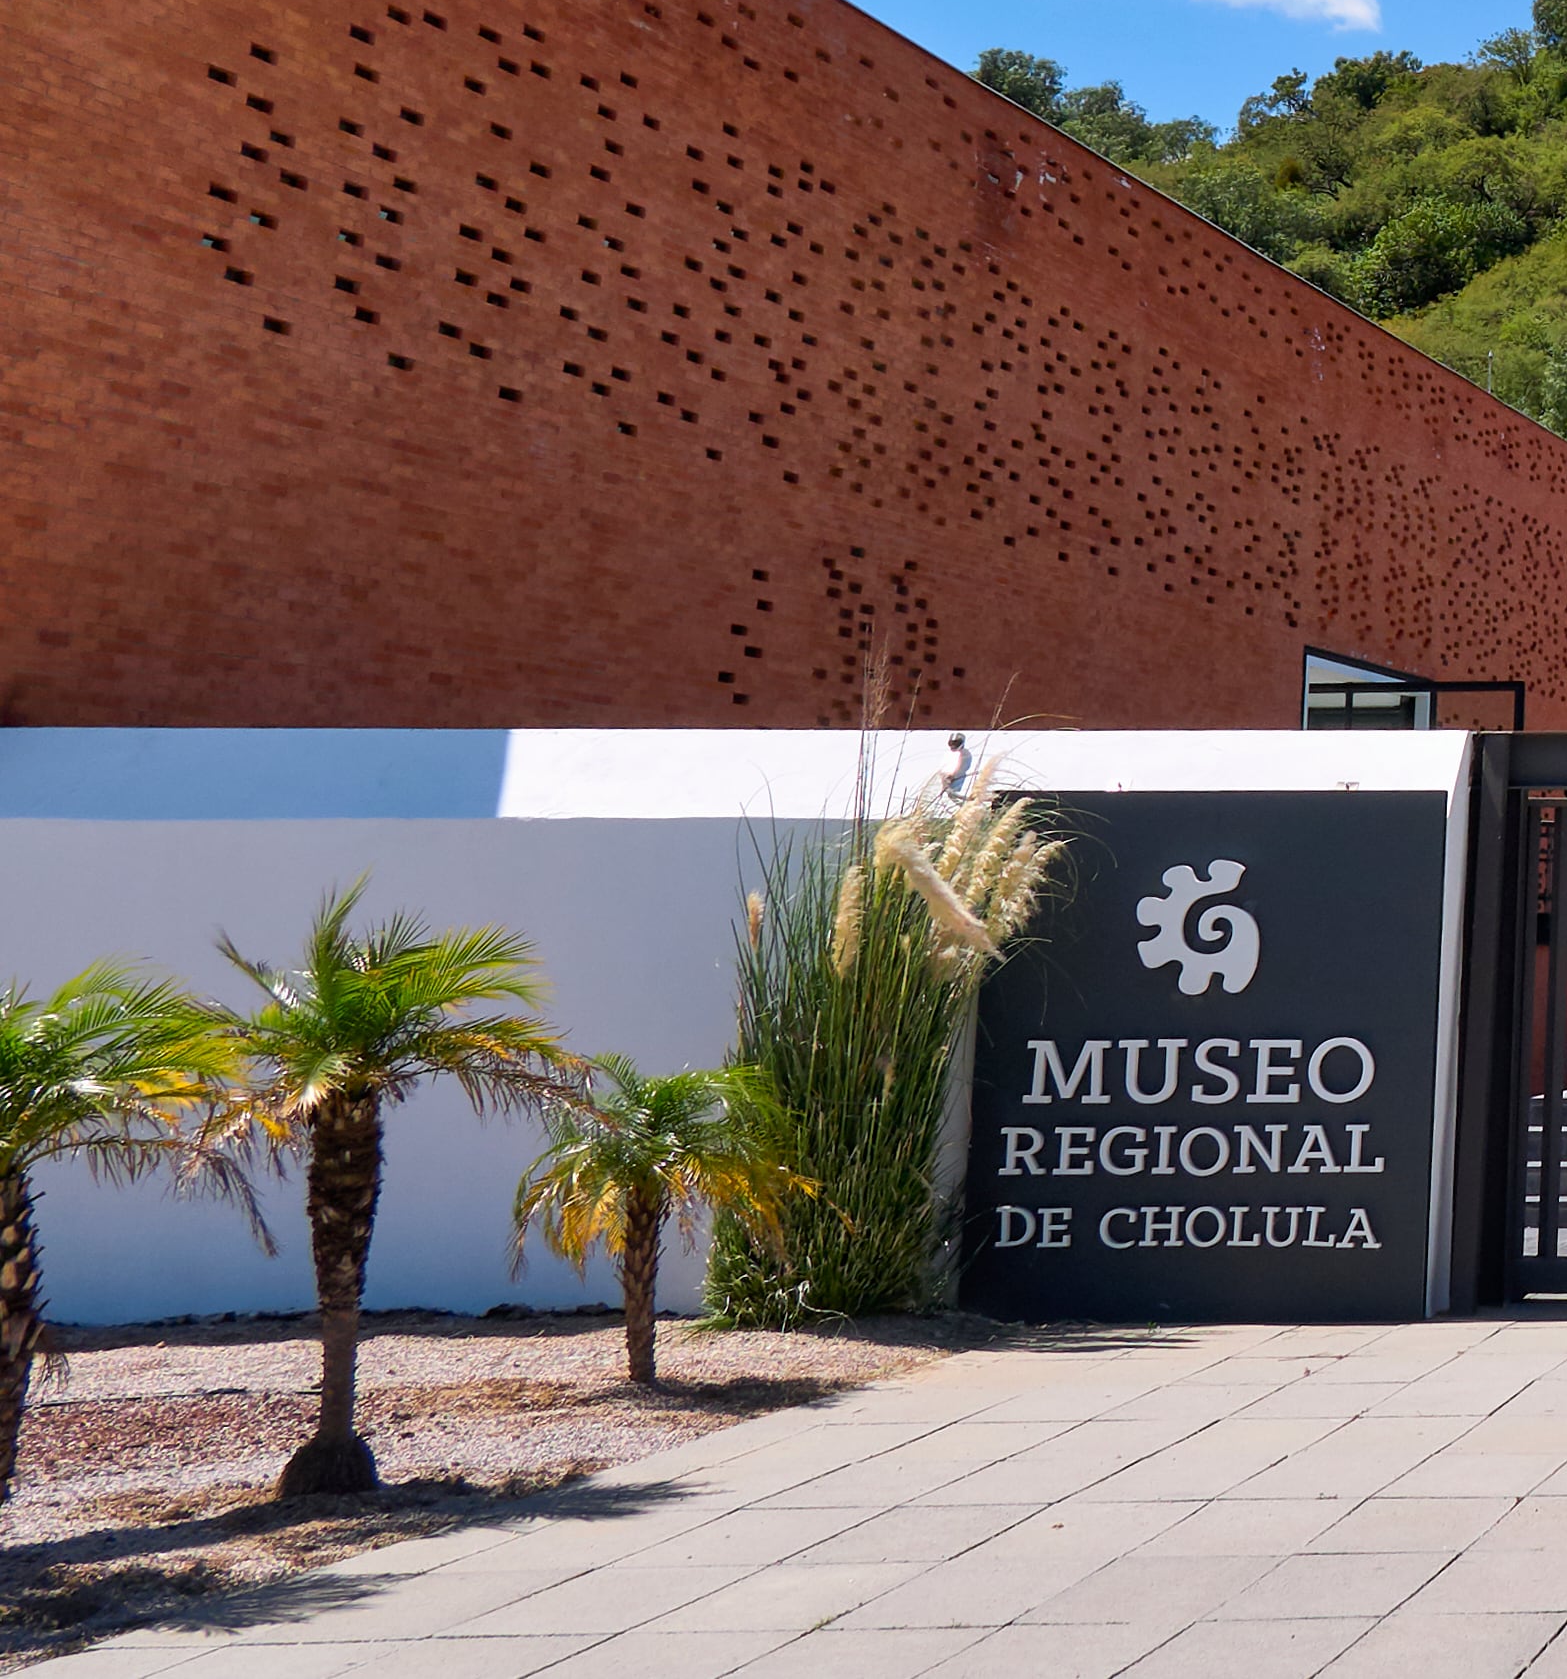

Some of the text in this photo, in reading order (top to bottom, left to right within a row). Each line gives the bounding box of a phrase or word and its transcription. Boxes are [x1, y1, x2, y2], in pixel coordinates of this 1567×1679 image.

[1021, 1036, 1376, 1105] MUSEO
[998, 1123, 1386, 1177] REGIONAL
[994, 1205, 1383, 1250] DE CHOLULA
